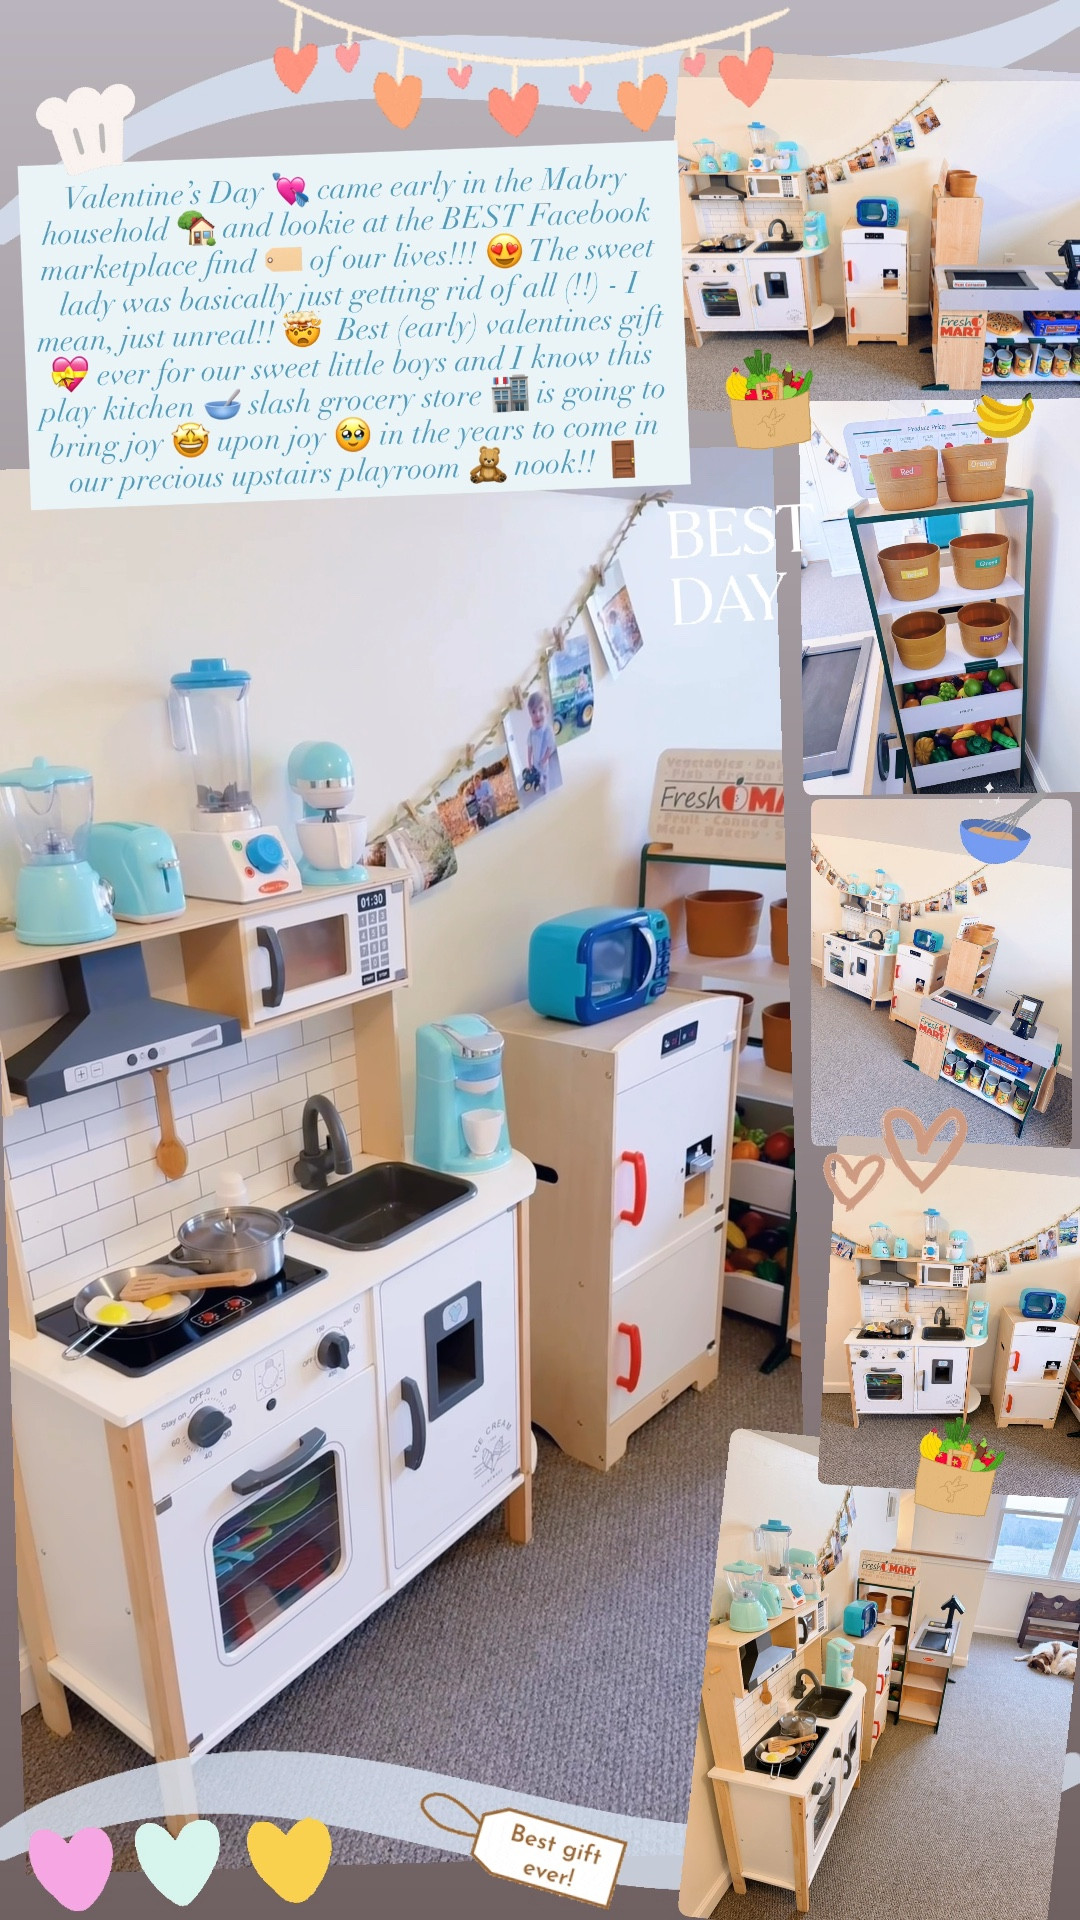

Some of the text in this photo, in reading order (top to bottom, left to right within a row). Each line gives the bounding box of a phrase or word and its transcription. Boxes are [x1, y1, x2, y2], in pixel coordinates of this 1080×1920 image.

[940, 316, 972, 327] Fresh
[940, 327, 981, 337] MART
[900, 467, 915, 476] Red
[660, 786, 721, 810] Fresh
[360, 893, 383, 909] 01:30
[919, 1023, 945, 1042] MART
[189, 1388, 211, 1405] OFF-0
[219, 1388, 227, 1398] 10
[228, 1404, 237, 1415] 20
[160, 1412, 187, 1431] Stay on
[222, 1430, 232, 1440] 30
[171, 1437, 181, 1448] 60
[182, 1455, 192, 1465] 50
[204, 1451, 213, 1461] 40
[861, 1560, 882, 1571] Fresh
[889, 1563, 917, 1577] MART
